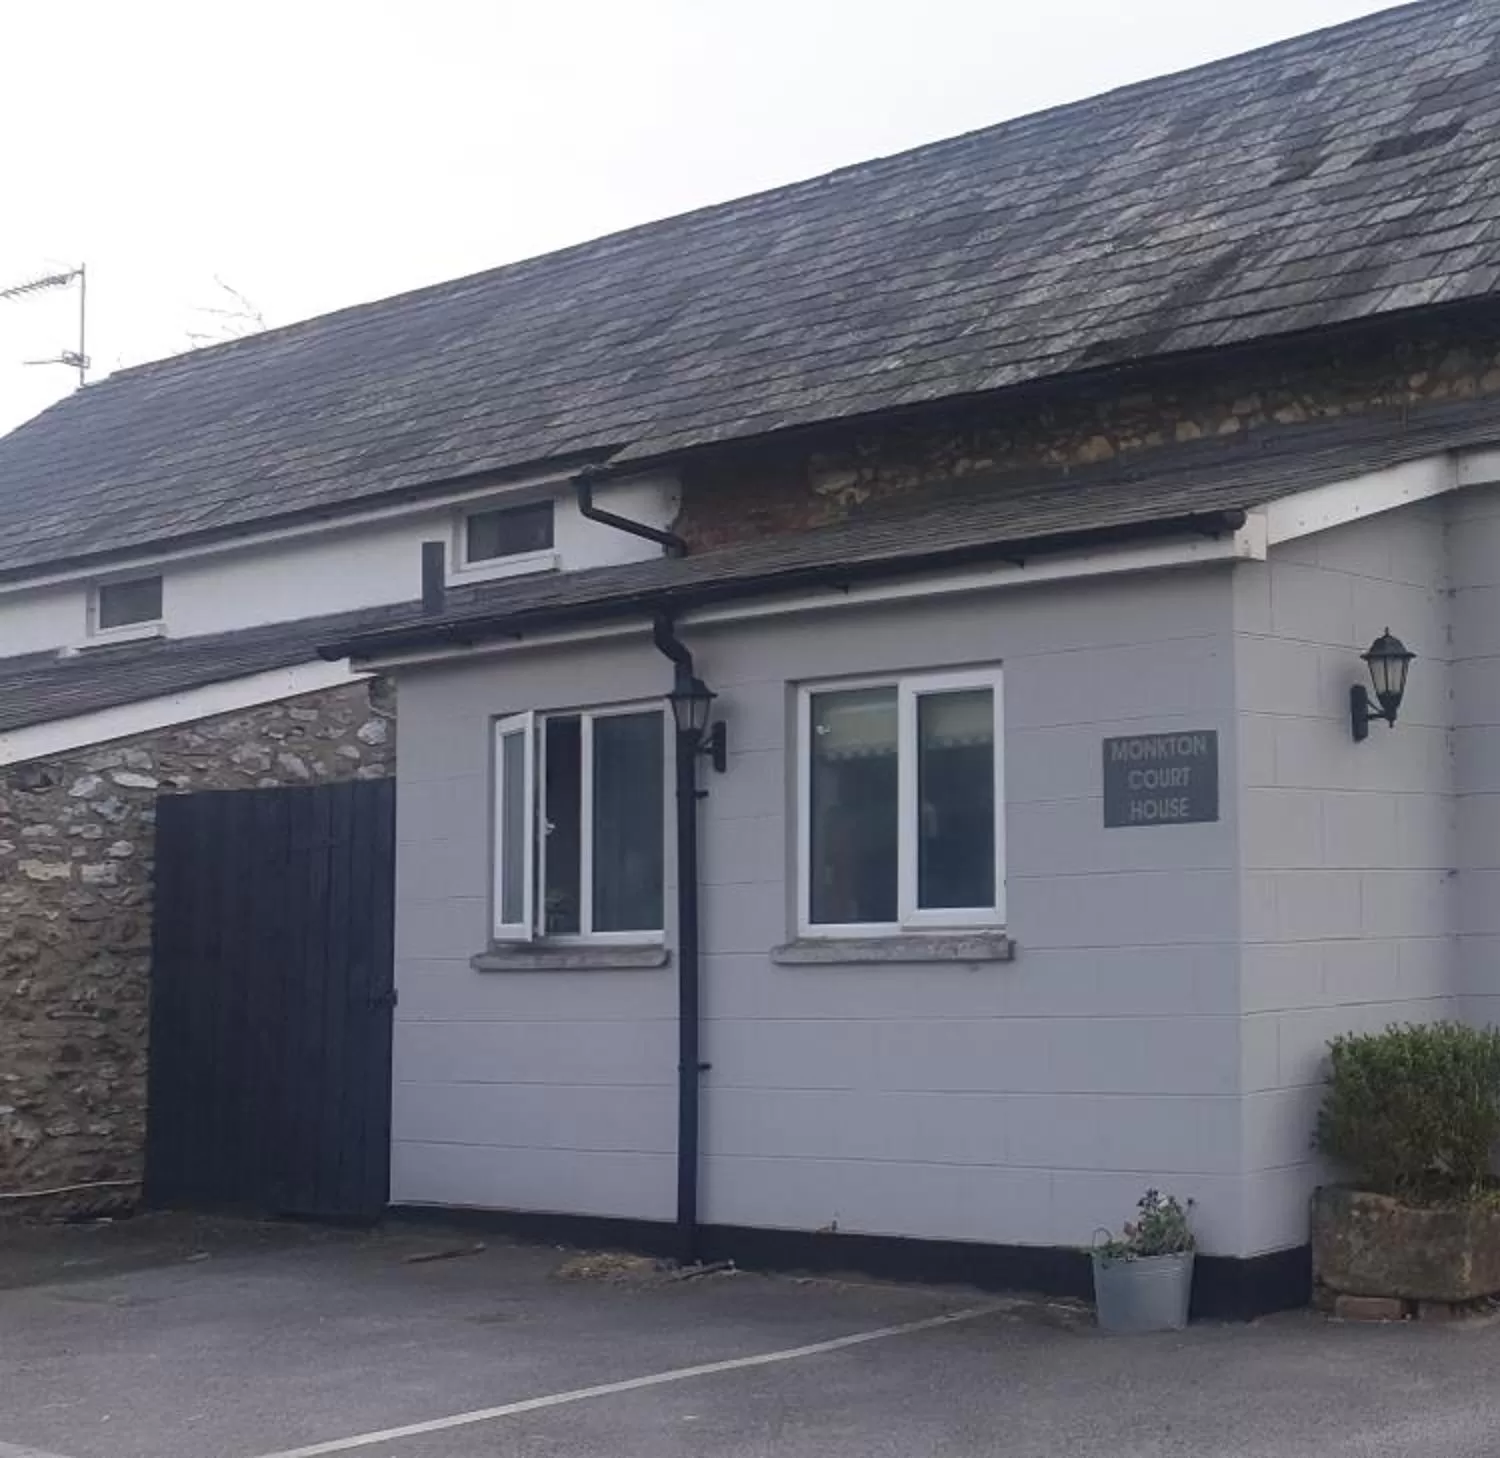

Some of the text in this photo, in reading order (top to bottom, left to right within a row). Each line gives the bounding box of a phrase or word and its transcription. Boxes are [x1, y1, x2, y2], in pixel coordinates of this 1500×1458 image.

[1111, 735, 1207, 761] MONKTON
[1128, 766, 1191, 790] COURT
[1130, 797, 1190, 820] HOUSE
